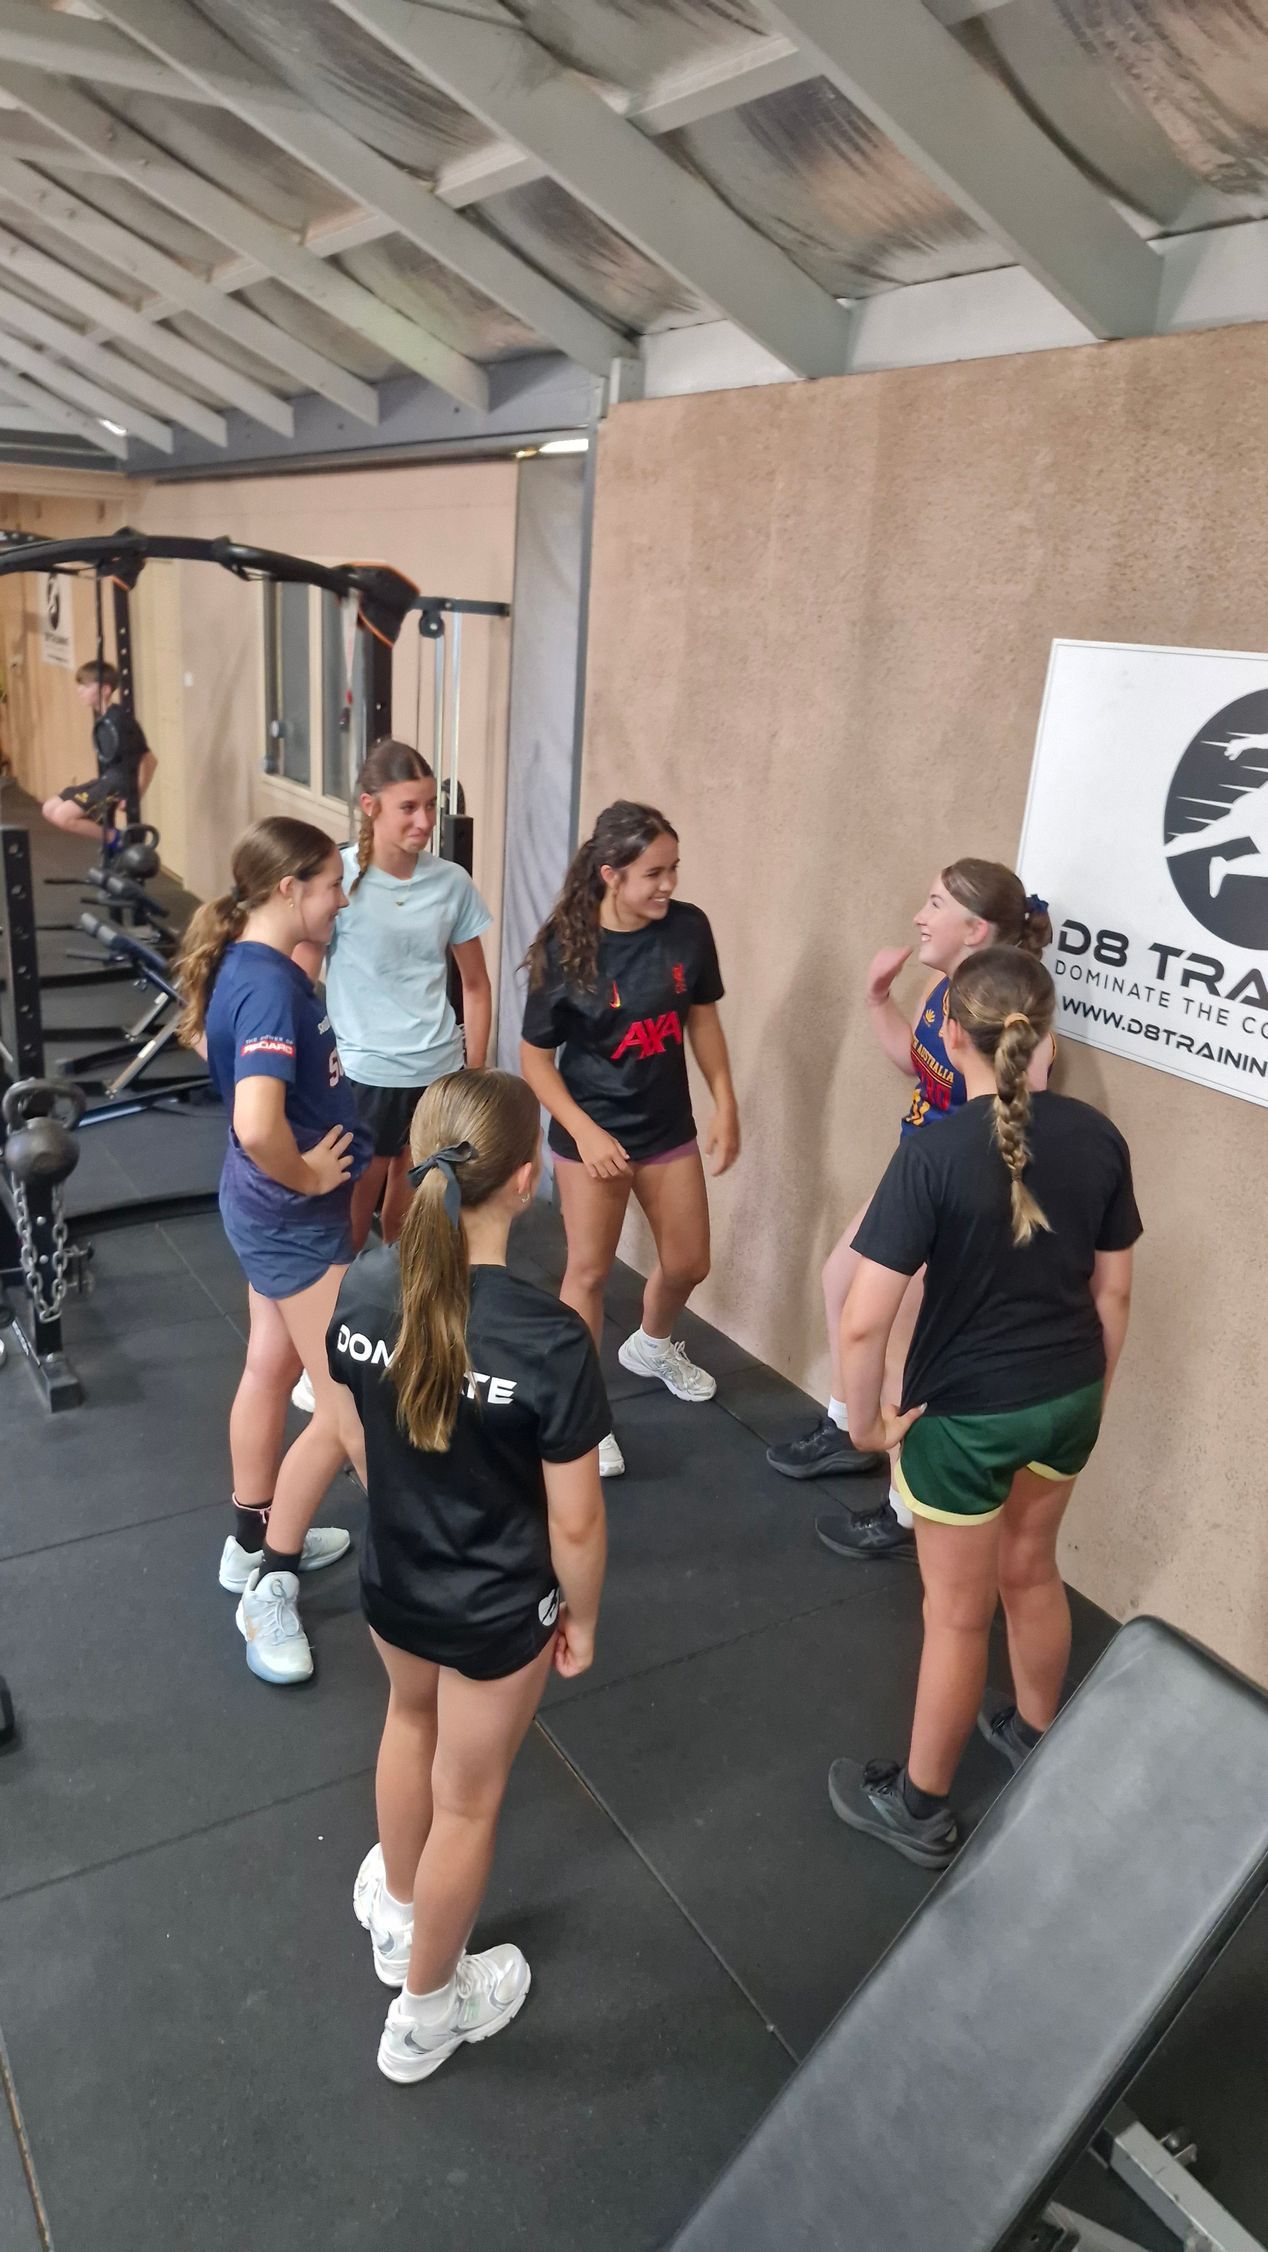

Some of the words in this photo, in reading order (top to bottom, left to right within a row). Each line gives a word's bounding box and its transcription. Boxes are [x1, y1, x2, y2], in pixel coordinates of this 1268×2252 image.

[1057, 919, 1129, 967] D8
[1055, 959, 1171, 1008] DOMINATE
[1184, 998, 1230, 1026] THE
[610, 1011, 683, 1061] AXA
[916, 1043, 954, 1083] AUSTRALIA
